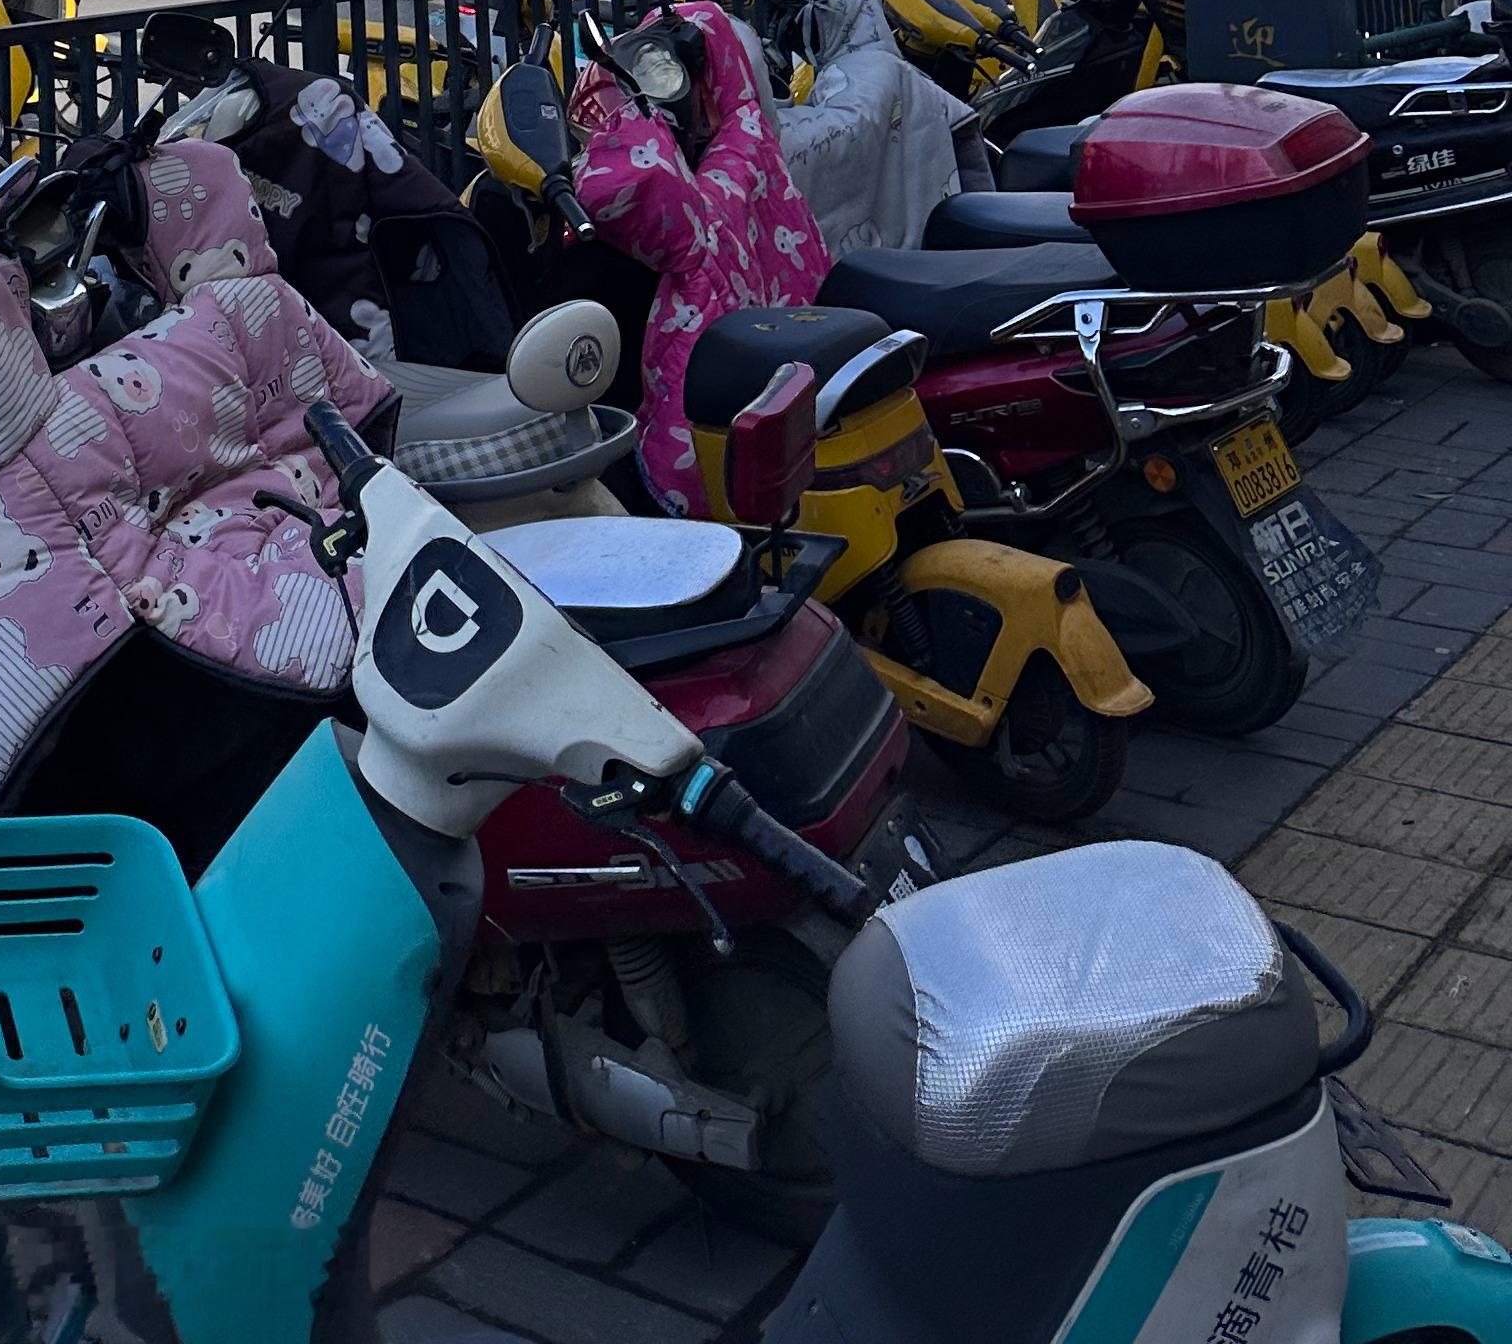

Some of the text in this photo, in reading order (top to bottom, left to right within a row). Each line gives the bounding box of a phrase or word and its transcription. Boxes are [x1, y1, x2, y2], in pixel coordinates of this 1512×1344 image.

[1229, 16, 1286, 68] 迎
[1406, 149, 1457, 175] 绿佳
[1234, 455, 1299, 509] 0083816
[1262, 535, 1341, 586] SUNRA
[325, 1022, 391, 1148] 自在骑行
